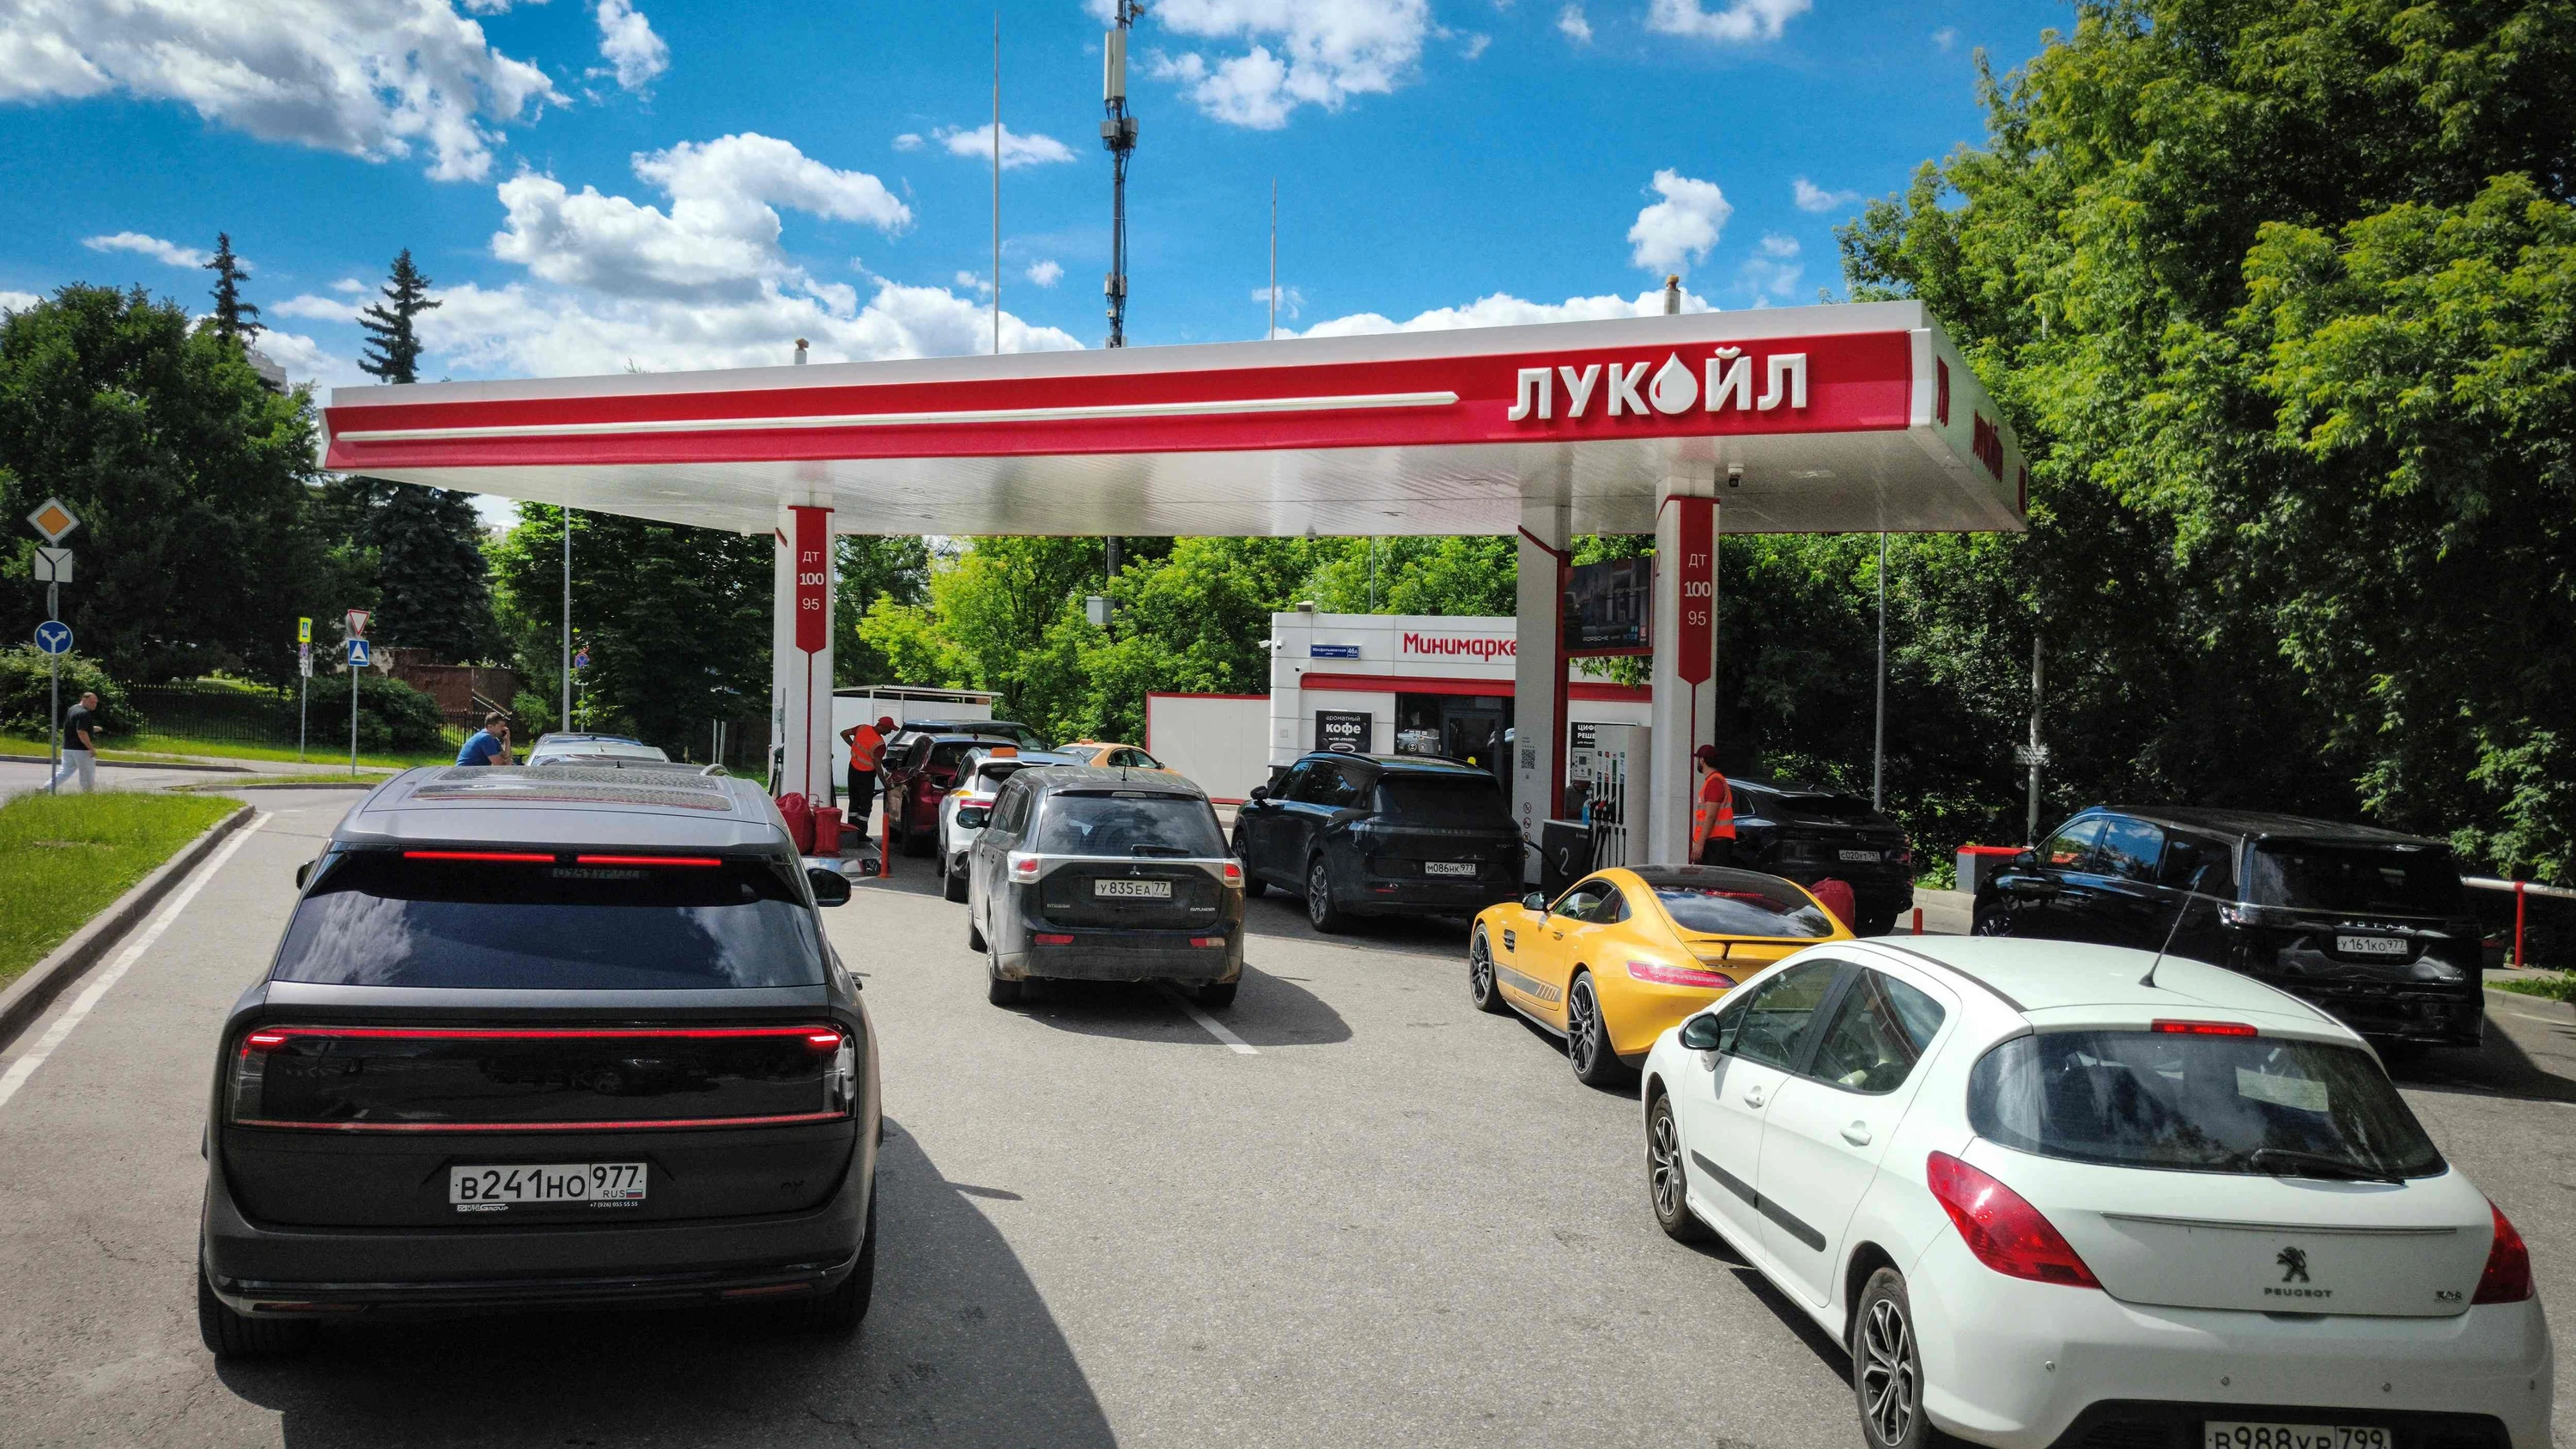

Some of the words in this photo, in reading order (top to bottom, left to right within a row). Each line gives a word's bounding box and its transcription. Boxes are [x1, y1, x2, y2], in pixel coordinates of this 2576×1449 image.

[1508, 345, 1807, 421] ЛУКОЙЛ
[802, 551, 820, 563] ДТ
[1688, 553, 1707, 568] ДТ
[799, 572, 824, 585] 100
[1684, 581, 1711, 597] 100
[802, 597, 820, 610] 95
[1688, 610, 1706, 625] 95
[1326, 721, 1361, 736] кофе
[1427, 863, 1460, 874] М086НК
[1559, 847, 1569, 875] 2
[1100, 882, 1151, 895] У835ЕА
[1154, 882, 1167, 892] 77
[2341, 938, 2385, 952] У161КО
[2387, 940, 2403, 948] 977
[461, 1169, 586, 1200] В241НО
[592, 1166, 639, 1188] 977
[2264, 1288, 2333, 1298] PEUGEOT
[2215, 1427, 2331, 1449] В988УР
[2338, 1428, 2384, 1449] 799
